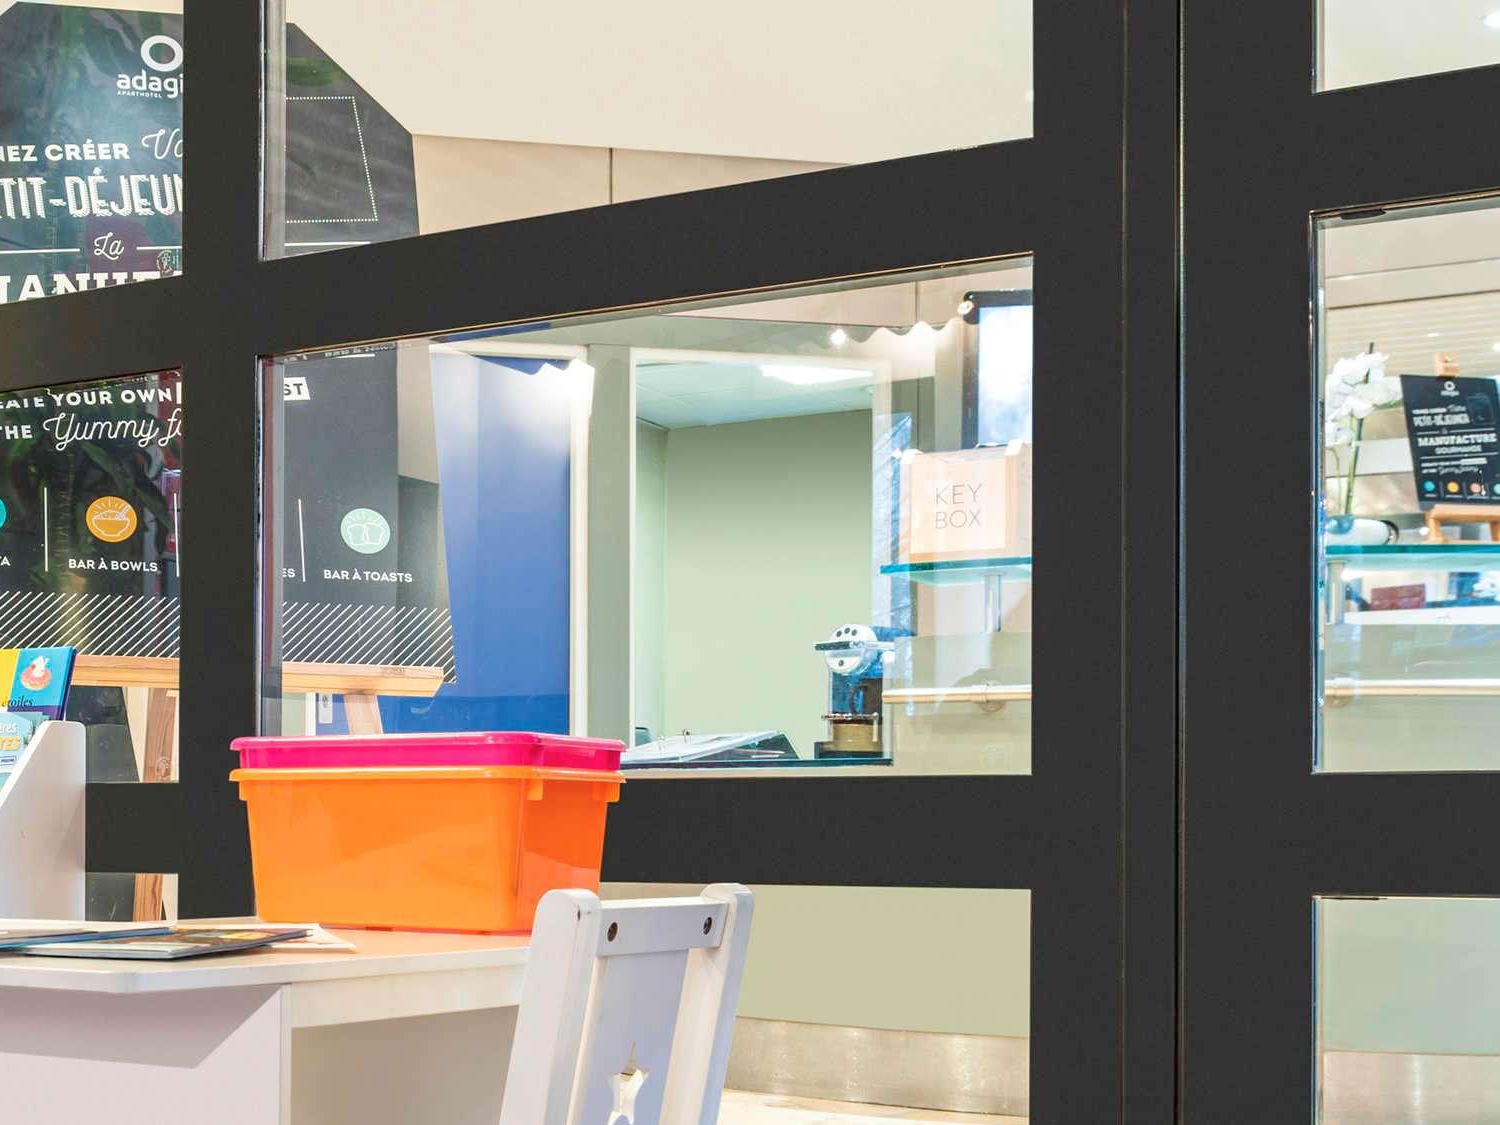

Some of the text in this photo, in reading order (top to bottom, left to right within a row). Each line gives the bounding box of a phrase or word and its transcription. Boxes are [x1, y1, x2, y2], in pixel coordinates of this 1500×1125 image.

[116, 68, 183, 98] adagi
[44, 138, 131, 161] CRÉER
[93, 232, 125, 261] La
[52, 391, 113, 408] YOUR
[120, 388, 172, 404] OWN
[43, 412, 160, 451] Yummy
[935, 482, 983, 505] KEY
[935, 508, 981, 530] BOX
[68, 557, 159, 573] BAR À BOWLS
[323, 567, 413, 583] BAR À TOASTS
